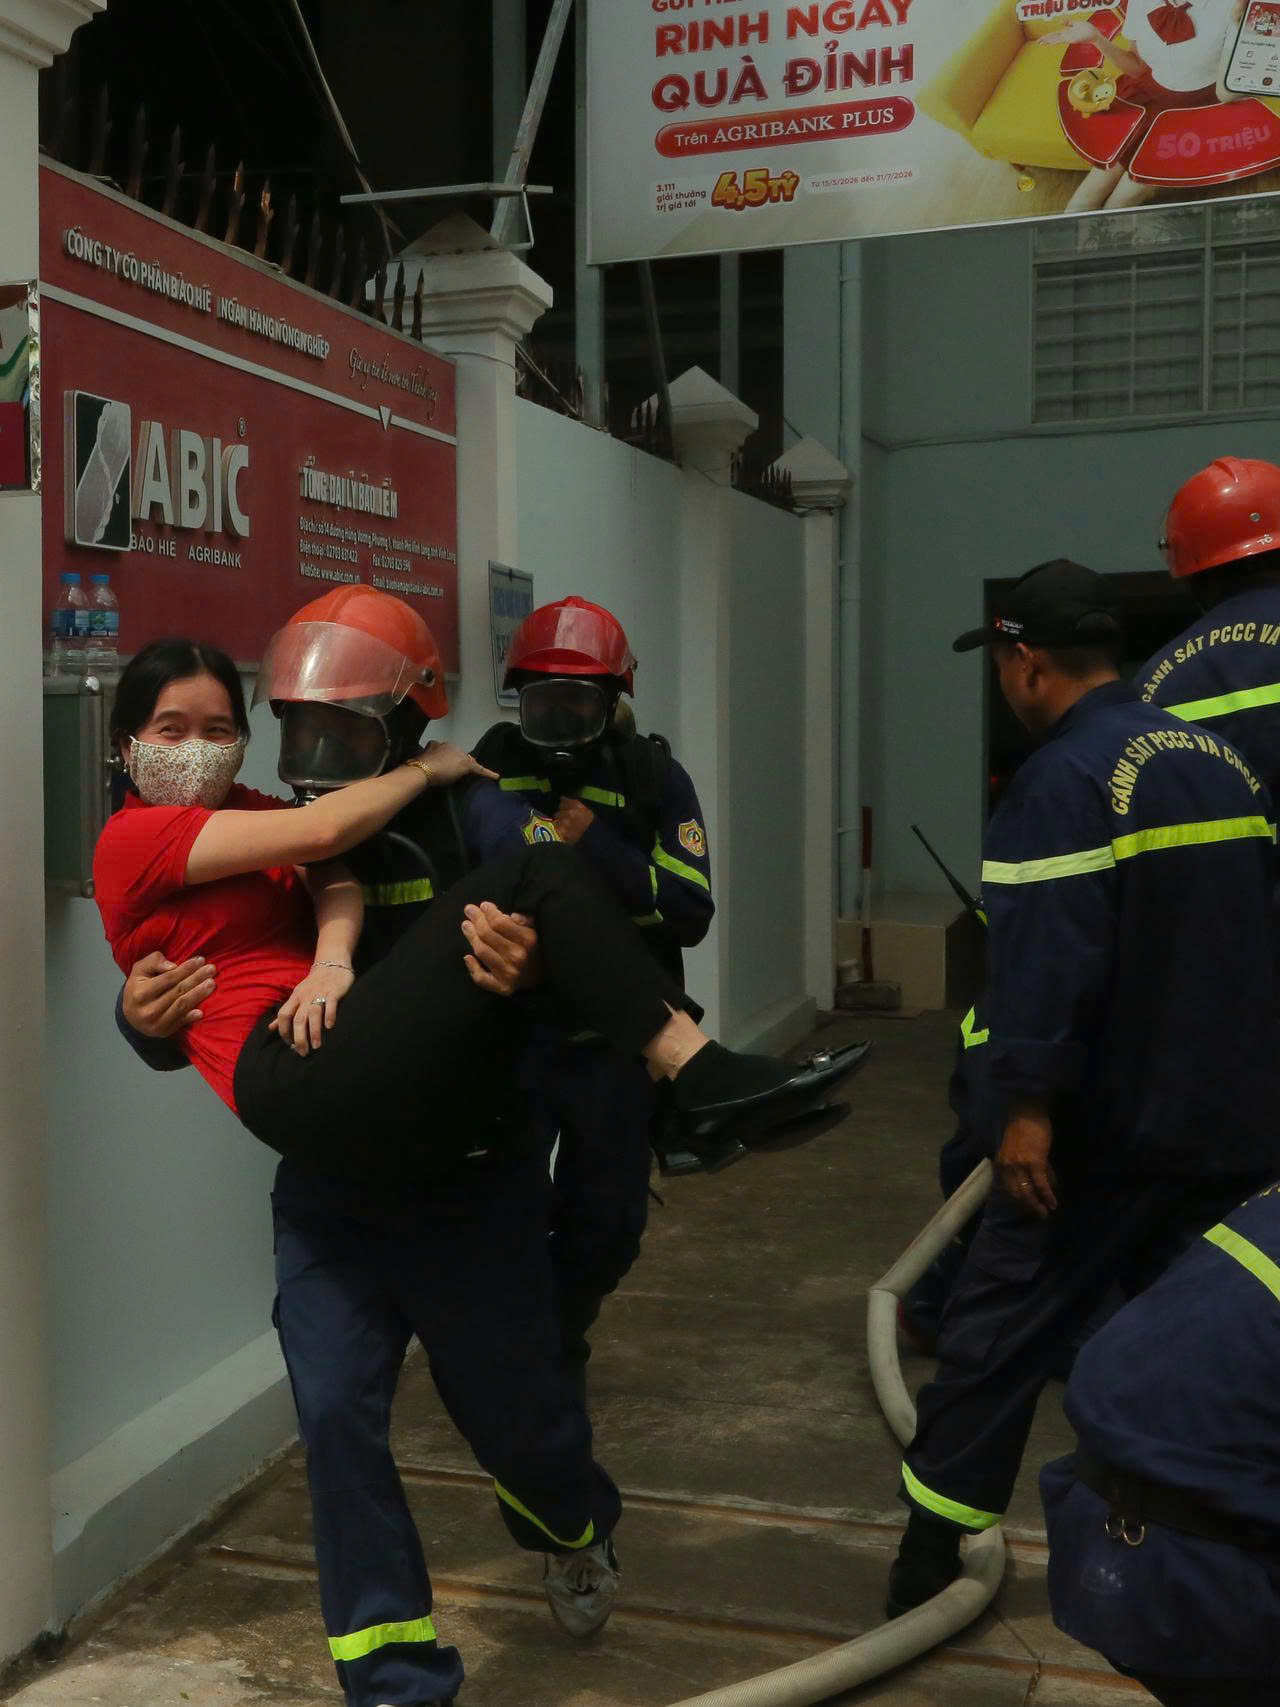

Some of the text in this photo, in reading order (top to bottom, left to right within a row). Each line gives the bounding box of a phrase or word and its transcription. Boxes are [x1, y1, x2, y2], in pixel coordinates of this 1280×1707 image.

[656, 0, 912, 57] RINH NGAY
[652, 39, 914, 113] QUÀ ĐỈNH
[675, 107, 895, 147] Trên AGRIBANK PLUS
[1155, 123, 1272, 159] 50 TRIỆU
[67, 224, 102, 266] CÔNG
[104, 245, 120, 273] TY
[219, 297, 249, 328] NGÂN
[136, 420, 250, 537] ABIC
[300, 456, 329, 503] TỔNG
[131, 529, 154, 553] BẢO
[188, 544, 242, 569] AGRIBANK
[1141, 622, 1257, 704] CẢNH SÁT PCCC
[1107, 730, 1222, 816] CẢNH SÁT PCCC VÀ
